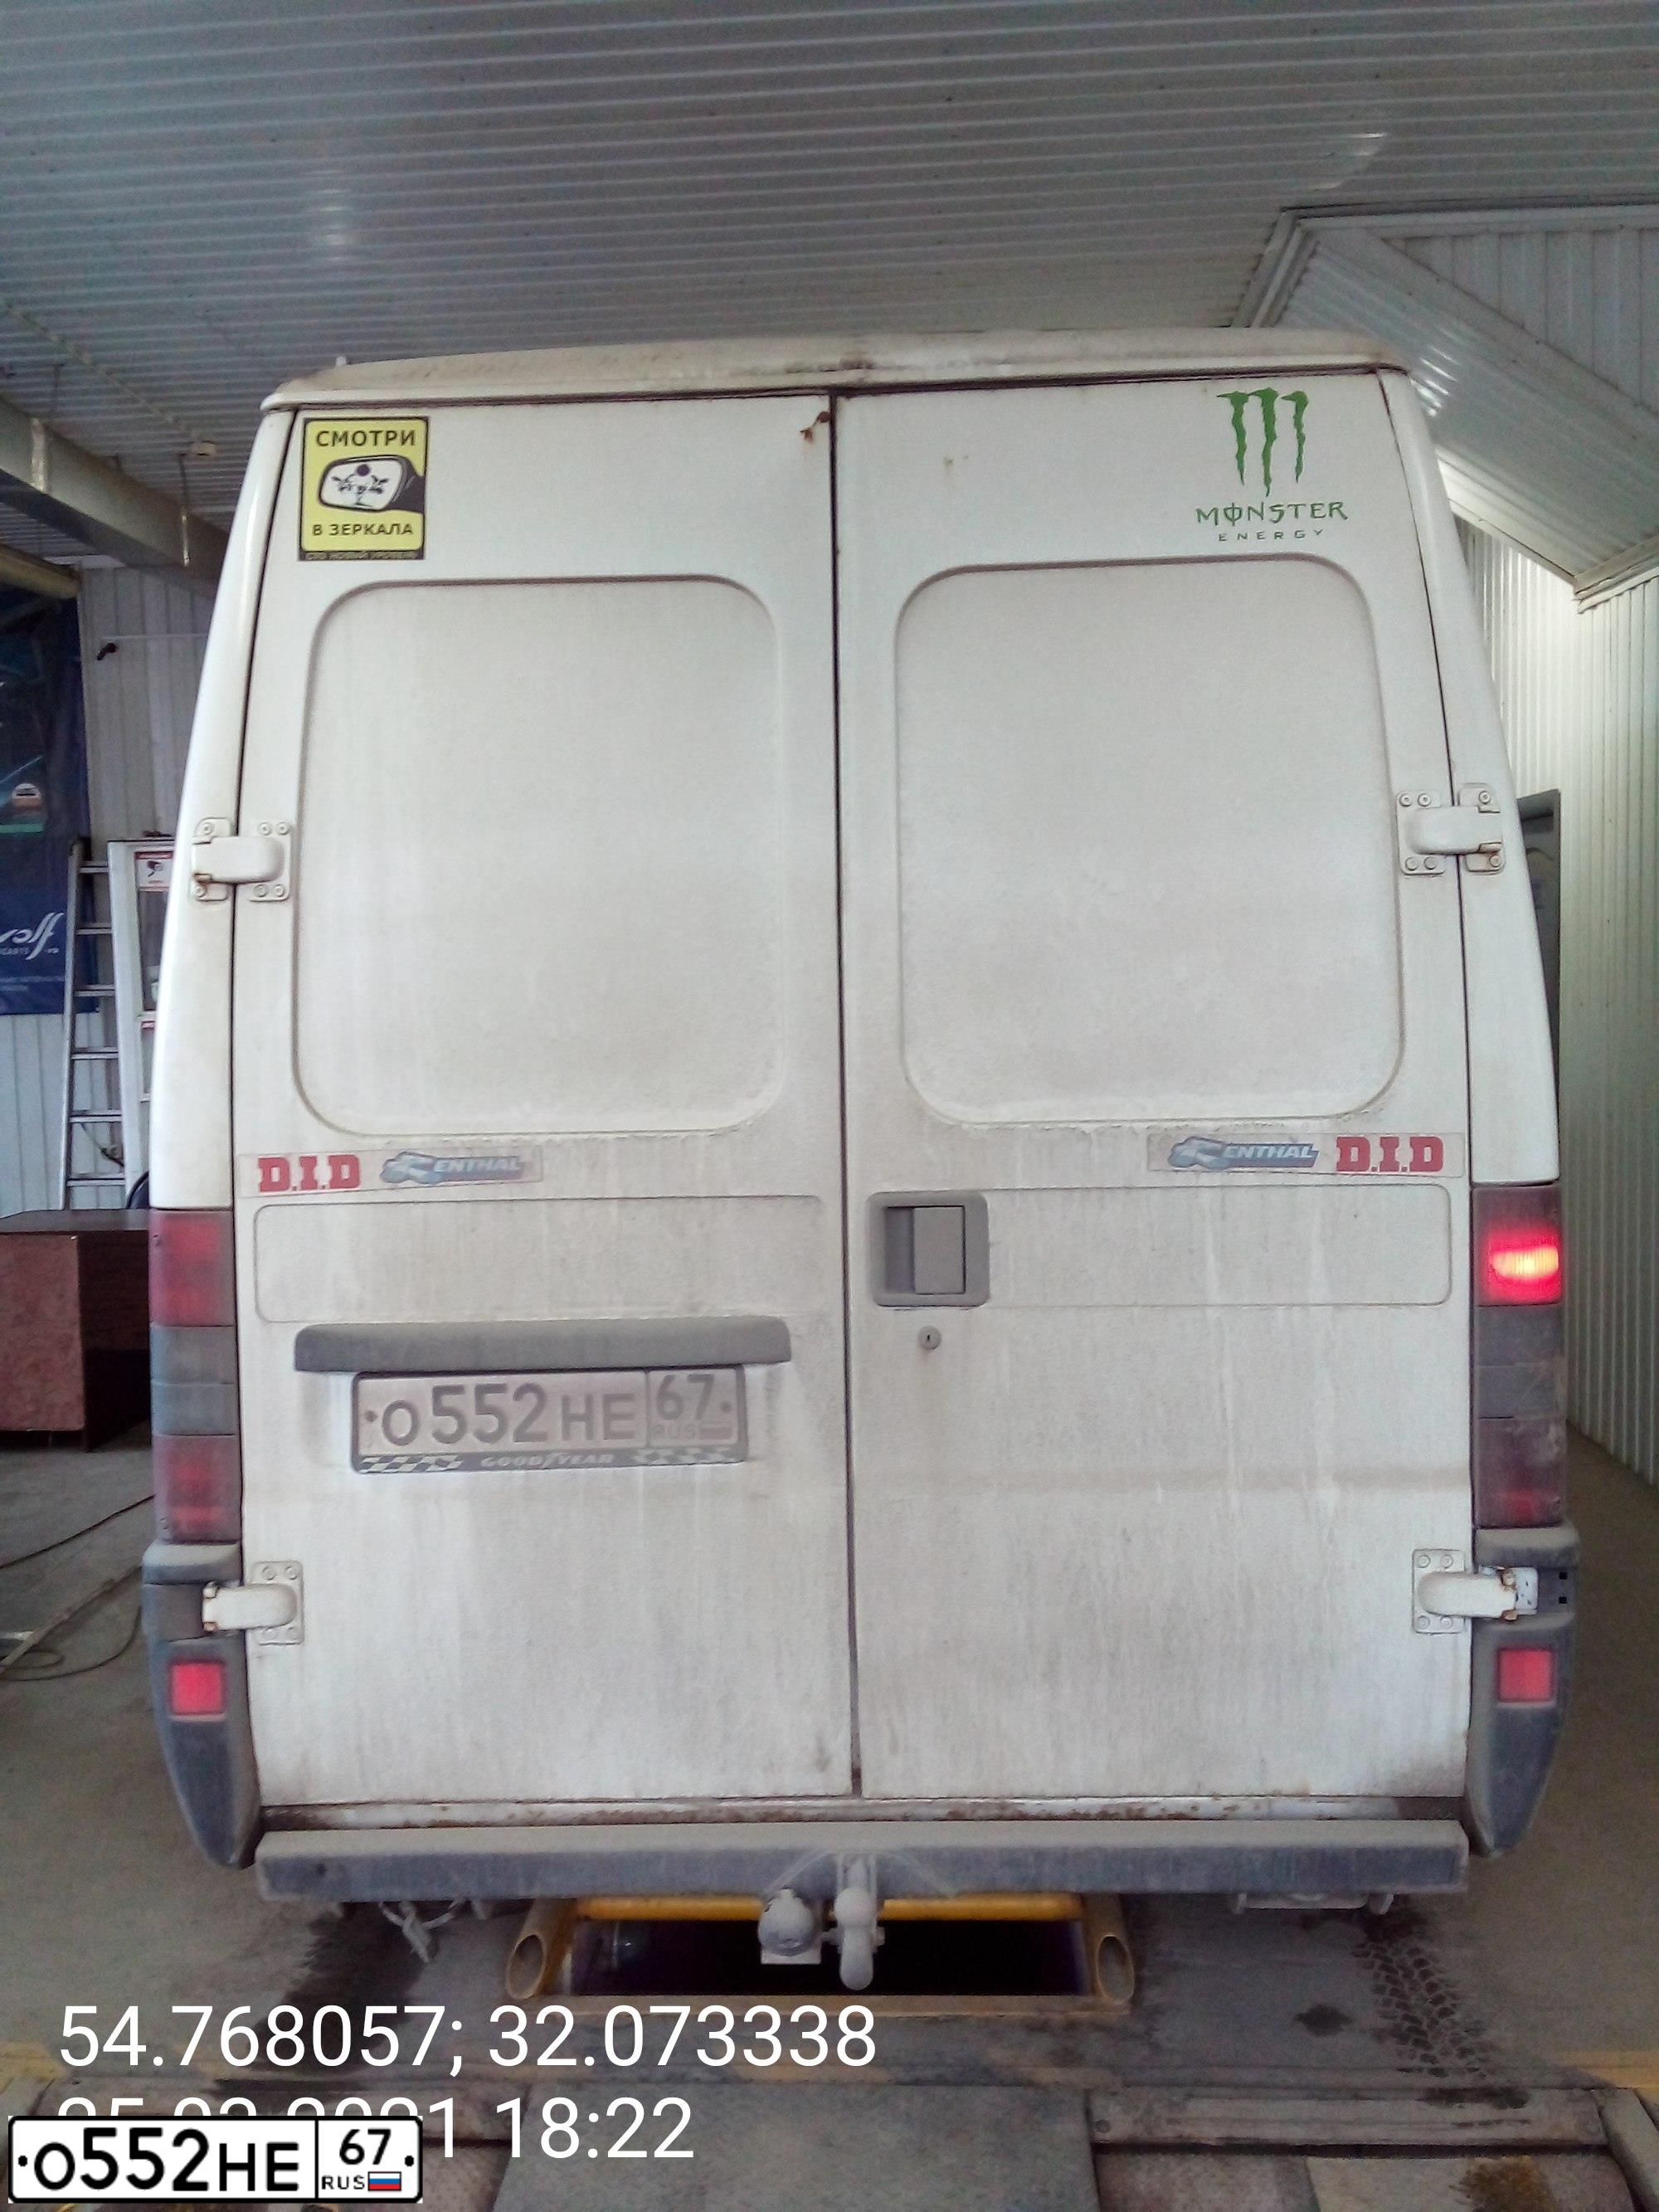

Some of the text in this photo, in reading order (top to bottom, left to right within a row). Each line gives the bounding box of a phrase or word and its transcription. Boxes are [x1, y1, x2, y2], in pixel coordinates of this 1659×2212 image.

[316, 430, 416, 447] СМОТРИ
[1195, 502, 1348, 526] MONSTER
[312, 523, 414, 536] В ЗЕРКАЛА
[1219, 529, 1323, 542] ENERGY
[1336, 1136, 1444, 1172] D.I.D
[258, 1154, 362, 1192] D.I.D
[656, 1373, 715, 1420] 67
